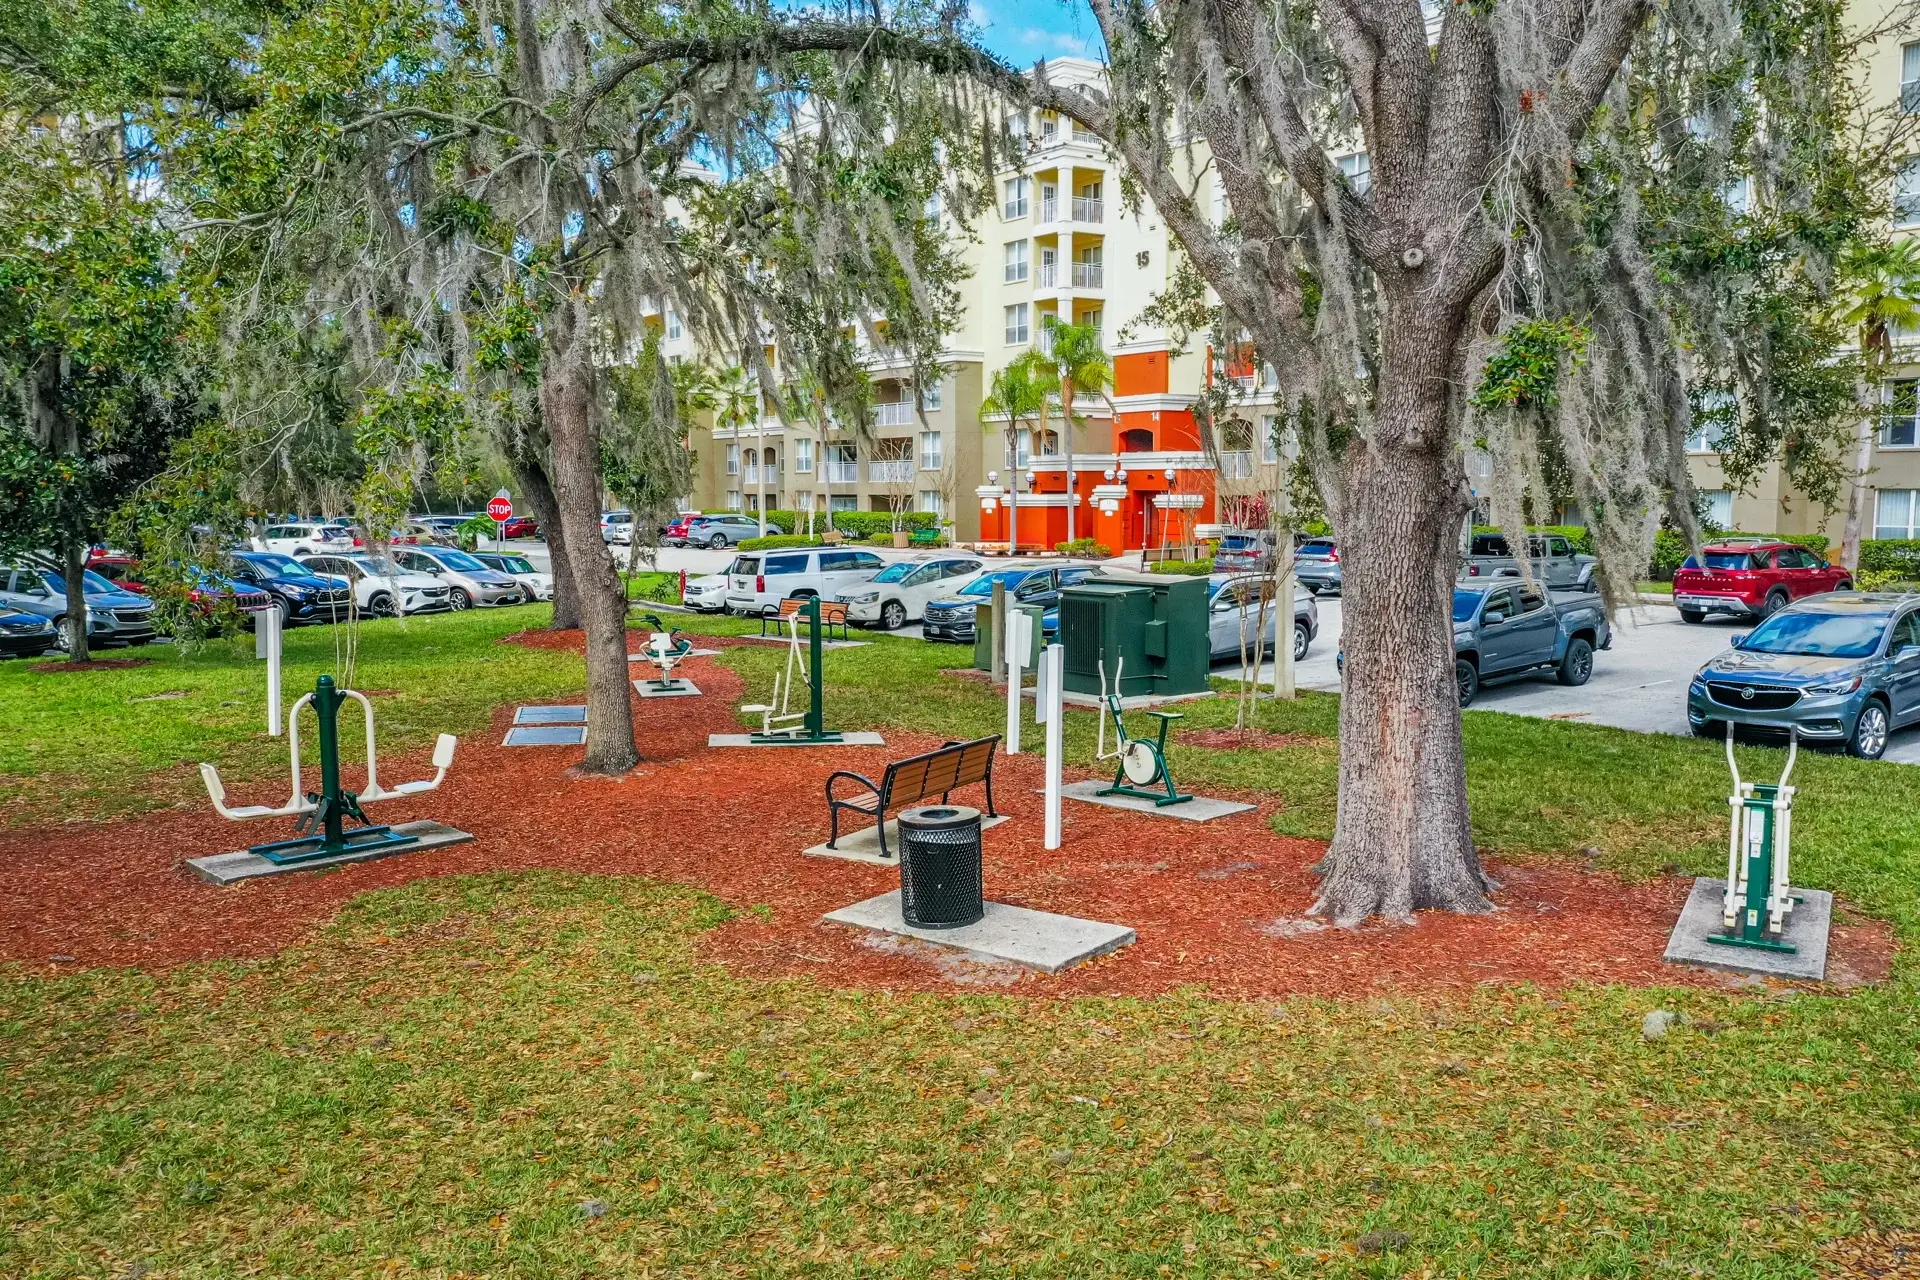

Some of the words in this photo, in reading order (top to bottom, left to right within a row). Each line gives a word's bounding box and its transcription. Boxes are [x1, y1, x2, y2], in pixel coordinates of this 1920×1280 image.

[1136, 250, 1150, 270] 15
[1151, 411, 1160, 421] 14
[488, 504, 511, 515] STOP
